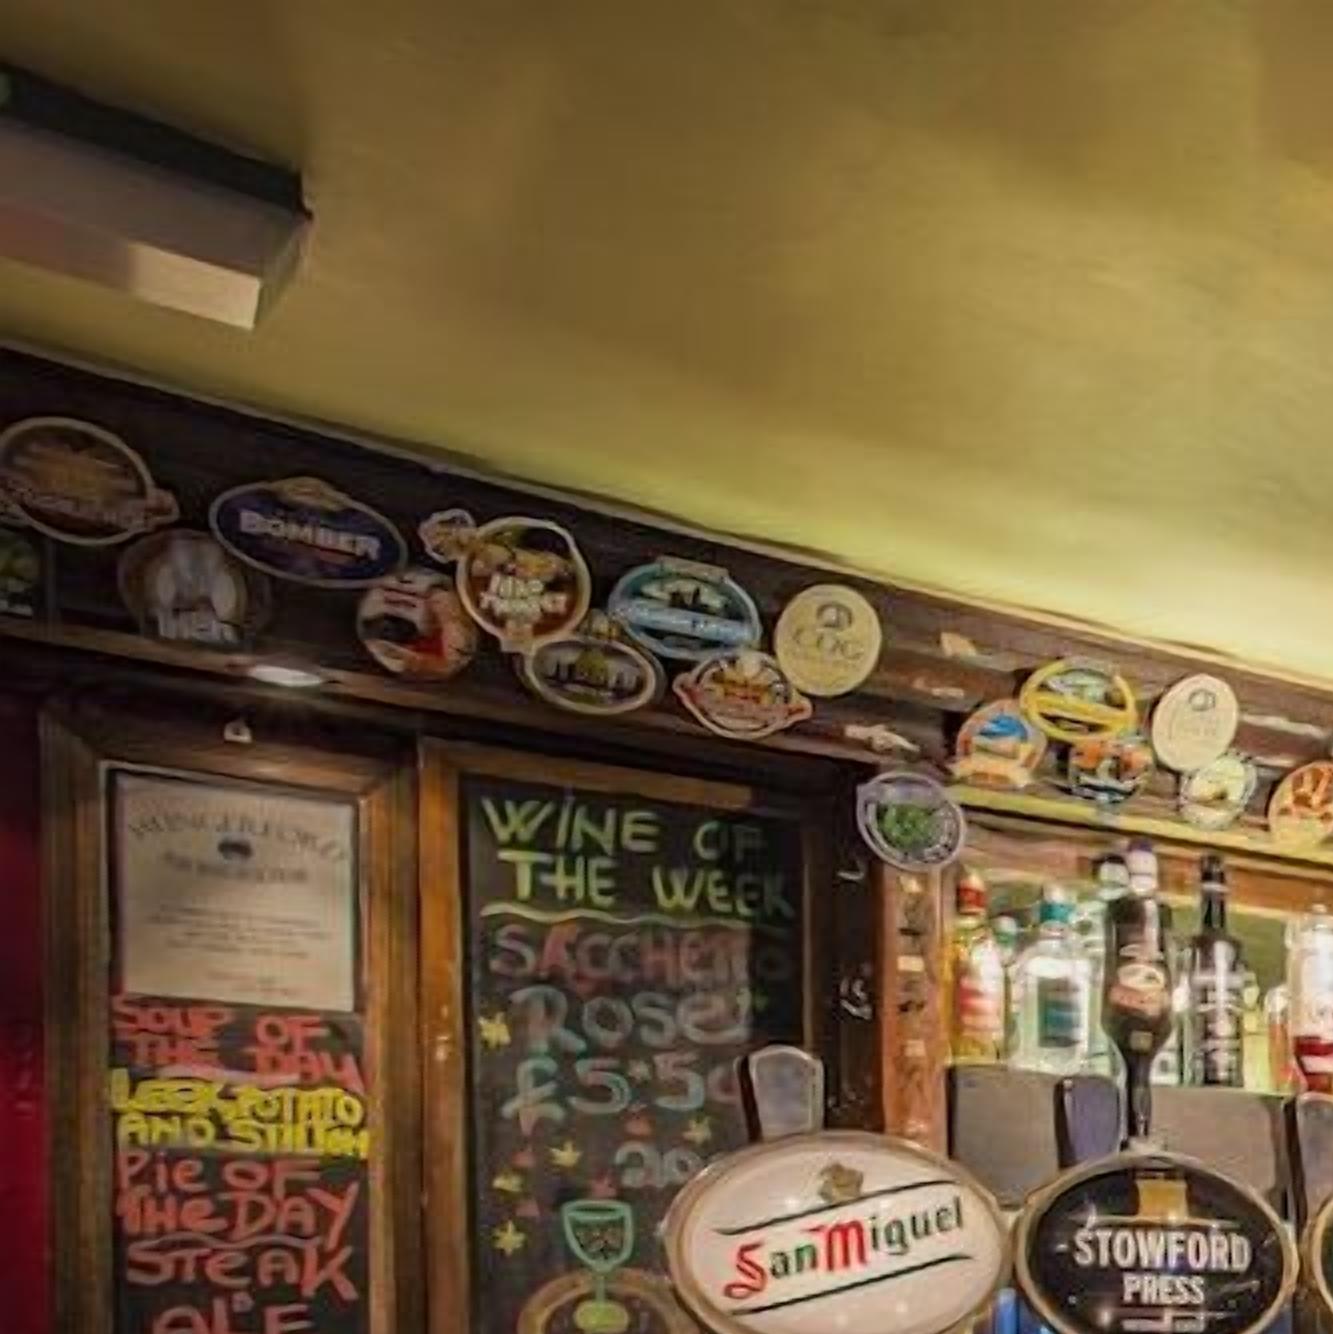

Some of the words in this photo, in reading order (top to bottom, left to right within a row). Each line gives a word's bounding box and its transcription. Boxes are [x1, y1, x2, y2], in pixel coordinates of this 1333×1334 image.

[481, 796, 662, 853] WINE
[693, 820, 768, 861] OF
[498, 851, 618, 906] THE
[652, 866, 796, 918] WEEK
[256, 1014, 330, 1051] OF
[127, 1032, 222, 1069] THE
[255, 1052, 365, 1096] DAY
[118, 1113, 216, 1149] AND
[222, 1158, 321, 1201] OF
[228, 1181, 360, 1250] DAY
[1073, 1221, 1253, 1274] STOWFORD
[1122, 1272, 1206, 1306] PRESS
